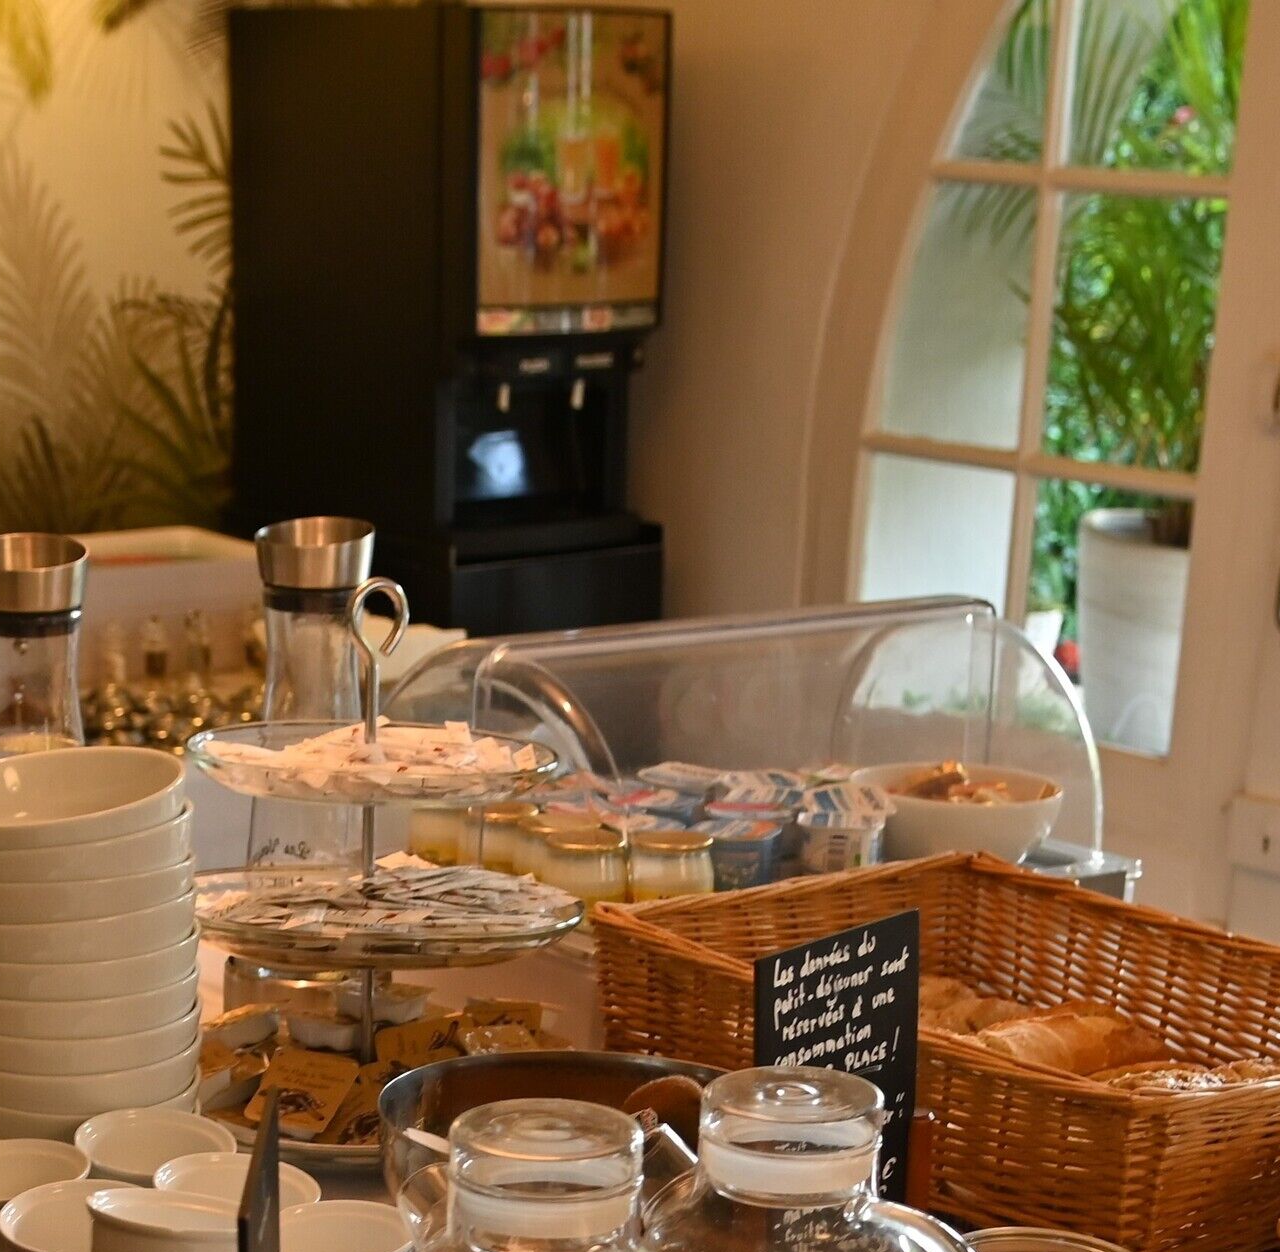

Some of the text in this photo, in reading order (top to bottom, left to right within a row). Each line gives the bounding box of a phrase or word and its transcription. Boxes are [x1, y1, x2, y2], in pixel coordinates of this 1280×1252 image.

[773, 929, 876, 988] Les denrées du
[880, 945, 910, 978] sont
[782, 987, 896, 1043] réservées à une
[774, 1022, 872, 1067] consommation
